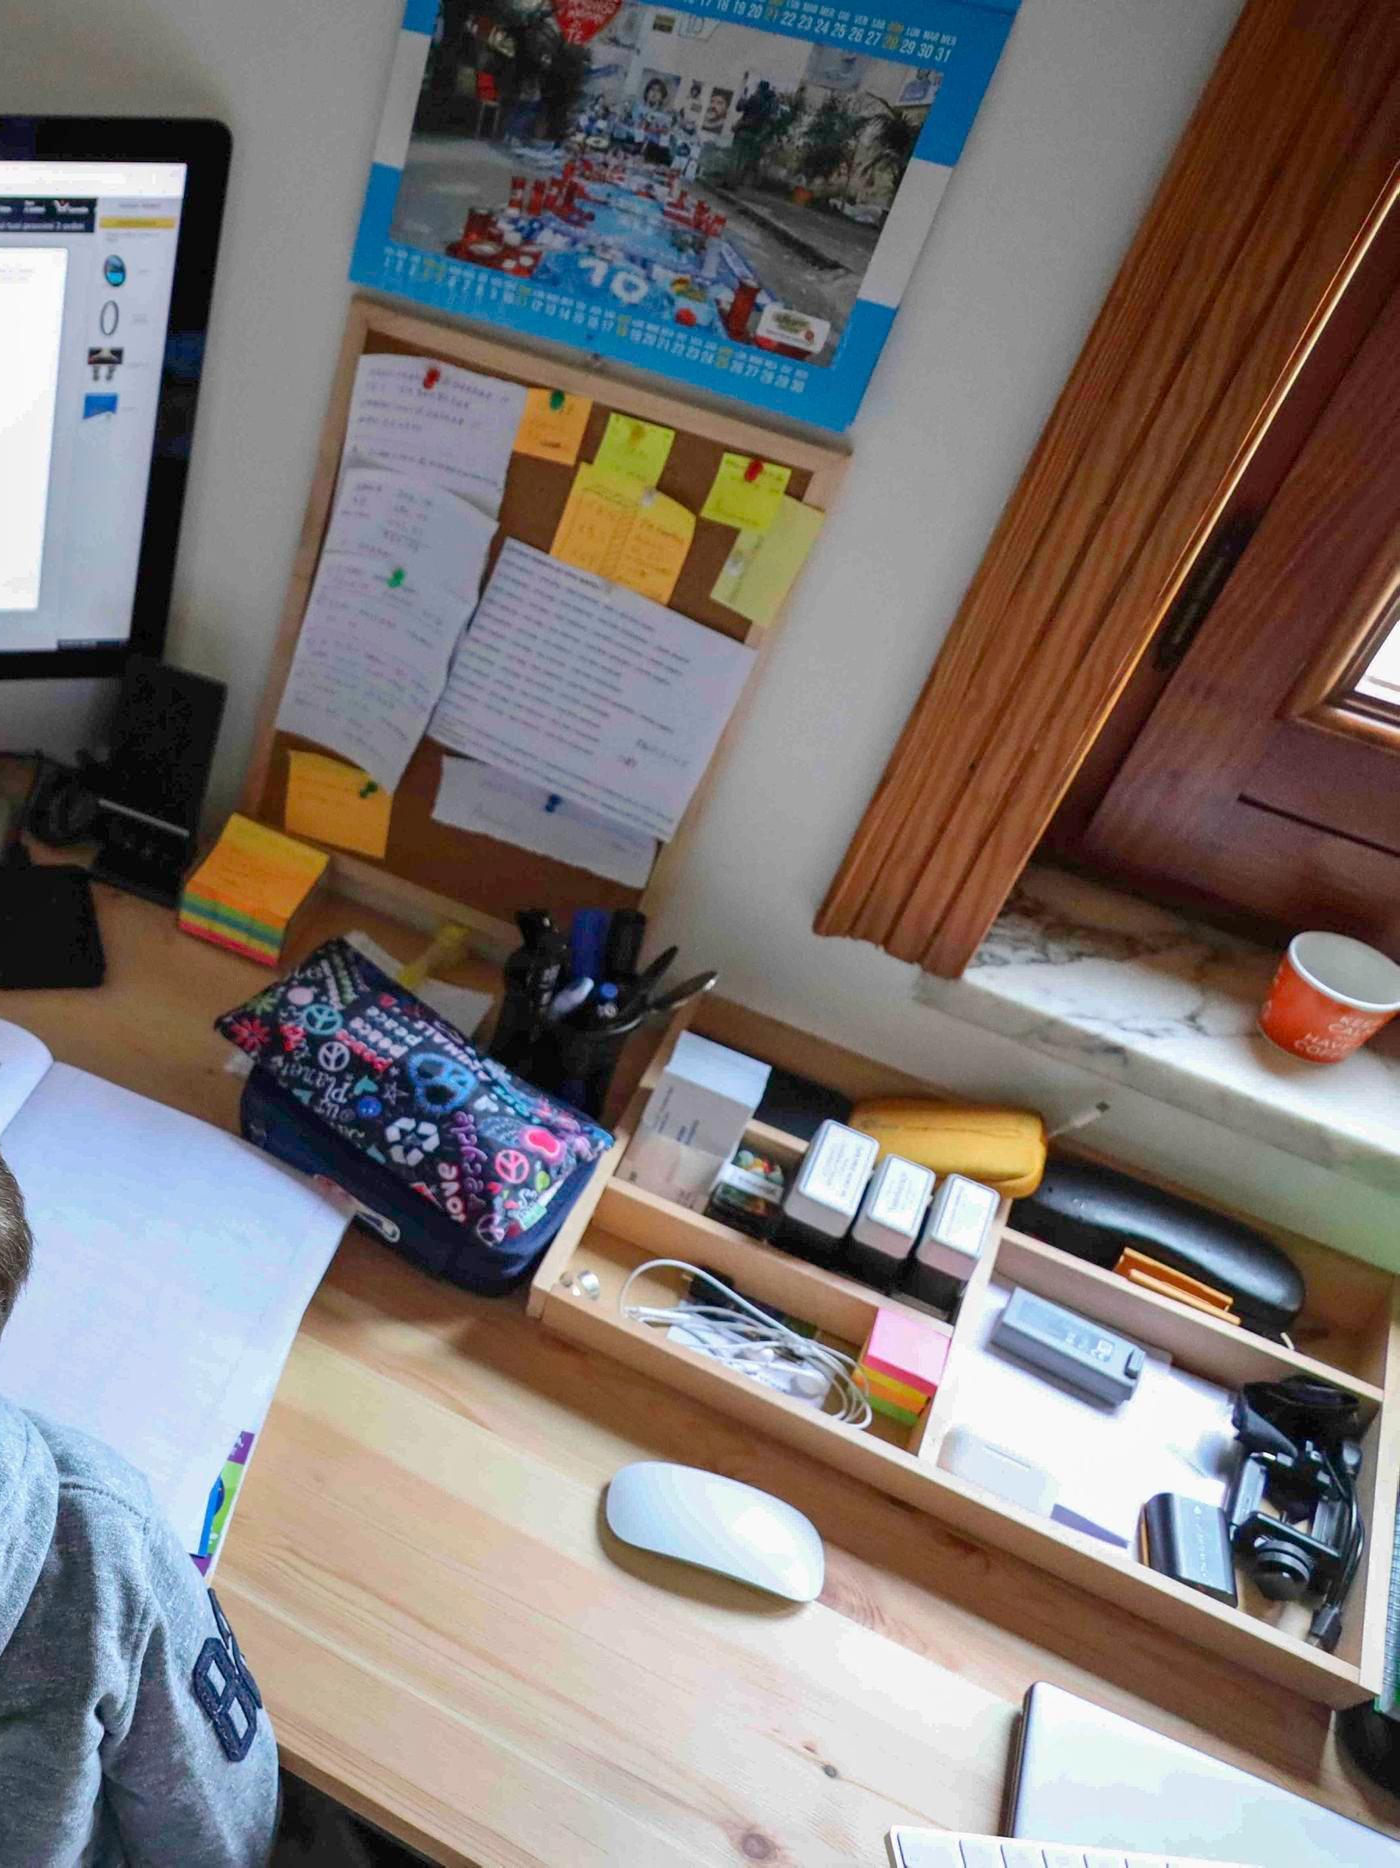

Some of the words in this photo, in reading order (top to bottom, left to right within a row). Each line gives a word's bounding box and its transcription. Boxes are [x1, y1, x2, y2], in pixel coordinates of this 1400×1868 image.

[733, 1, 745, 16] 19
[747, 4, 764, 19] 20
[780, 12, 796, 27] 22
[797, 15, 813, 30] 23
[814, 19, 830, 35] 24
[830, 23, 847, 38] 25
[848, 27, 863, 43] 26
[864, 30, 881, 46] 27
[899, 39, 915, 54] 29
[916, 43, 934, 58] 30
[934, 47, 951, 63] 31
[349, 1016, 408, 1060] peace
[364, 1004, 421, 1048] peace
